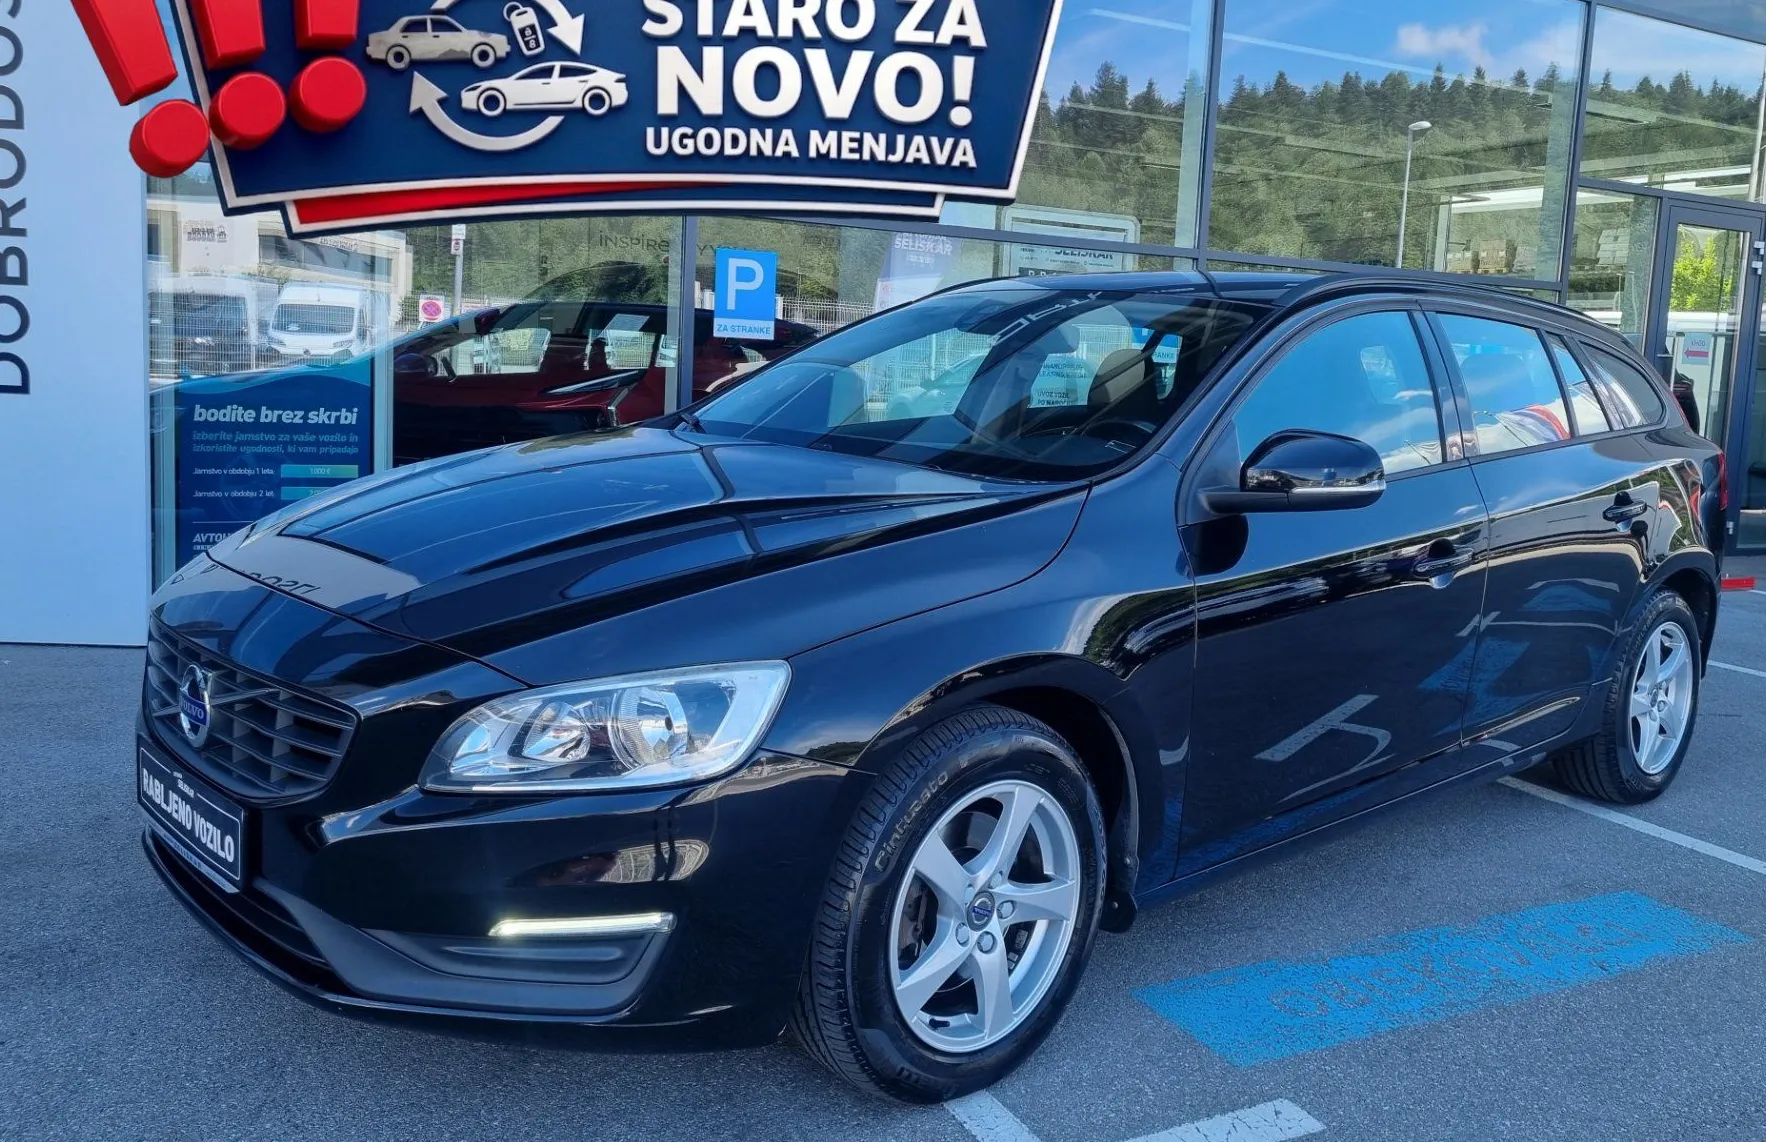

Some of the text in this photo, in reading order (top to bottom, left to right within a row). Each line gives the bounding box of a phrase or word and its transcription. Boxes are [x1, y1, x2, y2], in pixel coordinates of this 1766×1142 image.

[0, 0, 31, 395] DOBRODO
[726, 257, 764, 311] P
[716, 324, 771, 335] ZA STRANKE
[193, 404, 358, 425] bodite brez skrbi
[192, 430, 358, 443] izberite jamstvo za vaše vozilo in
[192, 444, 237, 453] izkoristite
[240, 444, 285, 454] ugodnosti,
[287, 445, 296, 453] ki
[319, 446, 358, 455] pripadajo
[193, 467, 222, 475] Jamstvo
[228, 467, 255, 477] obdobju
[230, 490, 257, 498] obdobju
[143, 768, 193, 831] RABLJENO
[193, 810, 235, 863] VOZILO
